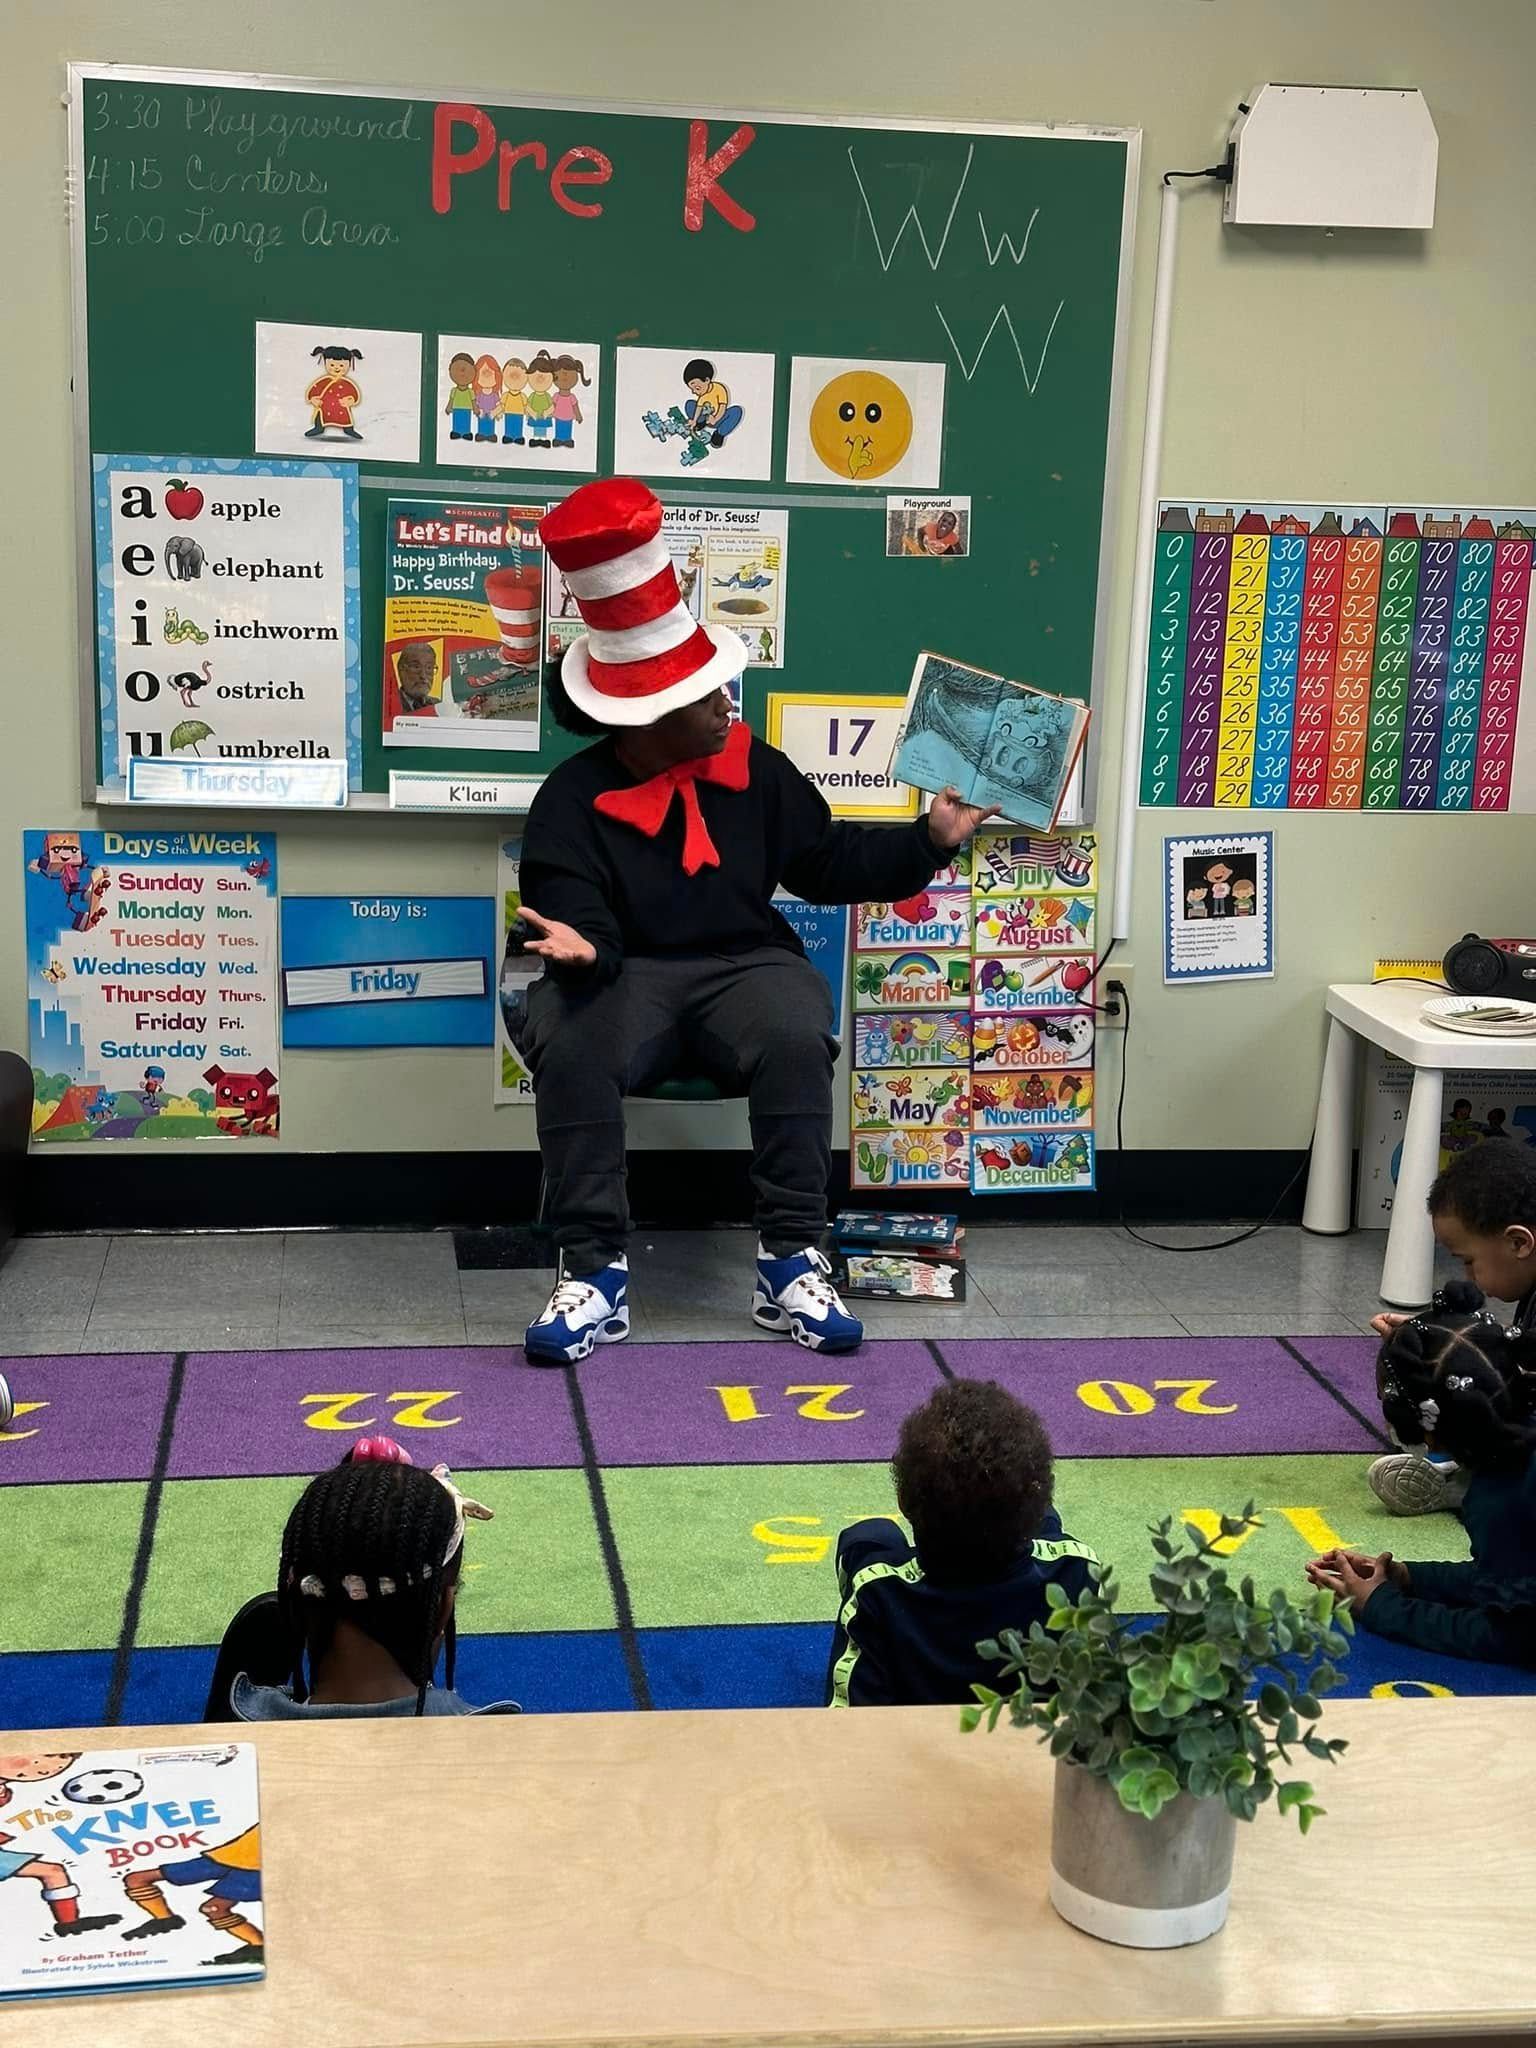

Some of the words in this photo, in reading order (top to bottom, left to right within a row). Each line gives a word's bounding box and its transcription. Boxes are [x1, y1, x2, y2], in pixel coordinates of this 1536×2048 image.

[186, 94, 421, 154] Playground
[87, 155, 162, 194] 4:15
[187, 154, 328, 193] Centers
[432, 103, 613, 217] Pre
[684, 120, 756, 232] K
[178, 207, 284, 263] Large
[302, 206, 399, 245] Area
[935, 300, 1064, 395] W
[121, 486, 157, 519] a
[211, 498, 281, 521] apple
[662, 509, 686, 522] orld
[689, 510, 703, 522] of
[704, 511, 722, 522] Dr.
[725, 511, 760, 523] Seuss!
[904, 498, 952, 509] Playground
[400, 520, 450, 541] Let's
[455, 523, 501, 544] Find
[122, 544, 155, 576] e
[212, 559, 324, 581] elephant
[1166, 536, 1183, 557] 0
[1200, 536, 1226, 558] 10
[1234, 537, 1267, 559] 20
[1272, 536, 1304, 557] 30
[1312, 539, 1340, 560] 40
[1347, 538, 1380, 559] 50
[1388, 541, 1416, 562] 60
[1426, 542, 1453, 563] 70
[1462, 542, 1492, 564] 80
[1500, 544, 1527, 564] 90
[392, 554, 435, 572] Happy
[394, 574, 419, 591] Dr.
[423, 571, 476, 592] Seuss!
[131, 599, 152, 646] i
[214, 619, 339, 640] inchworm
[1160, 619, 1178, 640] 3
[1193, 620, 1219, 640] 13
[1227, 620, 1260, 641] 23
[1265, 620, 1298, 641] 33
[1305, 622, 1332, 643] 43
[1340, 622, 1372, 644] 53
[1380, 624, 1409, 644] 63
[1418, 624, 1444, 645] 73
[1454, 625, 1484, 646] 83
[1493, 626, 1519, 646] 93
[125, 671, 160, 702] o
[217, 681, 305, 700] ostrich
[1156, 701, 1172, 721] 6
[1189, 702, 1213, 722] 16
[1223, 702, 1254, 723] 26
[1260, 701, 1292, 723] 36
[1299, 703, 1326, 724] 46
[1335, 704, 1364, 725] 56
[1373, 704, 1402, 725] 66
[1412, 705, 1437, 726] 76
[1448, 706, 1476, 726] 86
[1486, 706, 1511, 727] 96
[126, 732, 162, 757] u
[218, 740, 330, 759] umbrella
[828, 718, 876, 756] 17
[182, 768, 294, 798] Thursday
[804, 768, 898, 788] eventeen
[449, 786, 498, 803] K'lani
[1152, 781, 1165, 802] 9
[1183, 782, 1207, 802] 19
[1217, 783, 1247, 803] 29
[1254, 783, 1284, 803] 39
[1294, 784, 1318, 804] 49
[1328, 784, 1357, 804] 59
[1368, 785, 1394, 805] 69
[1406, 785, 1430, 805] 79
[1441, 786, 1468, 806] 89
[1479, 786, 1502, 806] 99
[104, 833, 169, 858] Days
[171, 845, 189, 856] the
[174, 835, 185, 845] of
[189, 833, 261, 855] Week
[1192, 848, 1215, 856] Music
[1217, 846, 1245, 855] Center
[119, 873, 204, 893] Sunday
[217, 879, 251, 891] Sun.
[1015, 864, 1056, 891] July
[118, 901, 205, 921] Monday
[217, 906, 252, 919] Mon.
[350, 902, 401, 921] Today
[407, 902, 427, 918] is:
[796, 904, 817, 914] are
[821, 904, 838, 914] we
[804, 921, 817, 931] to
[870, 920, 962, 945] February
[997, 926, 1073, 951] August
[110, 929, 205, 950] Tuesday
[218, 934, 258, 946] Tues.
[73, 957, 206, 978] Wednesday
[219, 962, 258, 975] Wed.
[351, 968, 420, 995] Friday
[881, 981, 950, 1004] March
[102, 985, 206, 1005] Thursday
[219, 990, 266, 1002] Thurs.
[984, 988, 1078, 1011] September
[135, 1013, 207, 1033] Friday
[219, 1018, 244, 1030] Fri.
[101, 1041, 207, 1060] Saturday
[220, 1045, 251, 1057] Sat.
[890, 1041, 942, 1066] April
[995, 1046, 1072, 1066] October
[890, 1099, 939, 1125] May
[984, 1107, 1080, 1126] November
[890, 1160, 941, 1186] June
[987, 1165, 1078, 1186] December
[716, 1384, 865, 1424] 21
[1075, 1378, 1238, 1417] 20
[300, 1391, 463, 1431] 22
[6, 1808, 73, 1832] The
[52, 1799, 221, 1856] KNEE
[105, 1831, 210, 1868] BOOK
[57, 1952, 105, 1963] Graham
[108, 1949, 149, 1959] Tether
